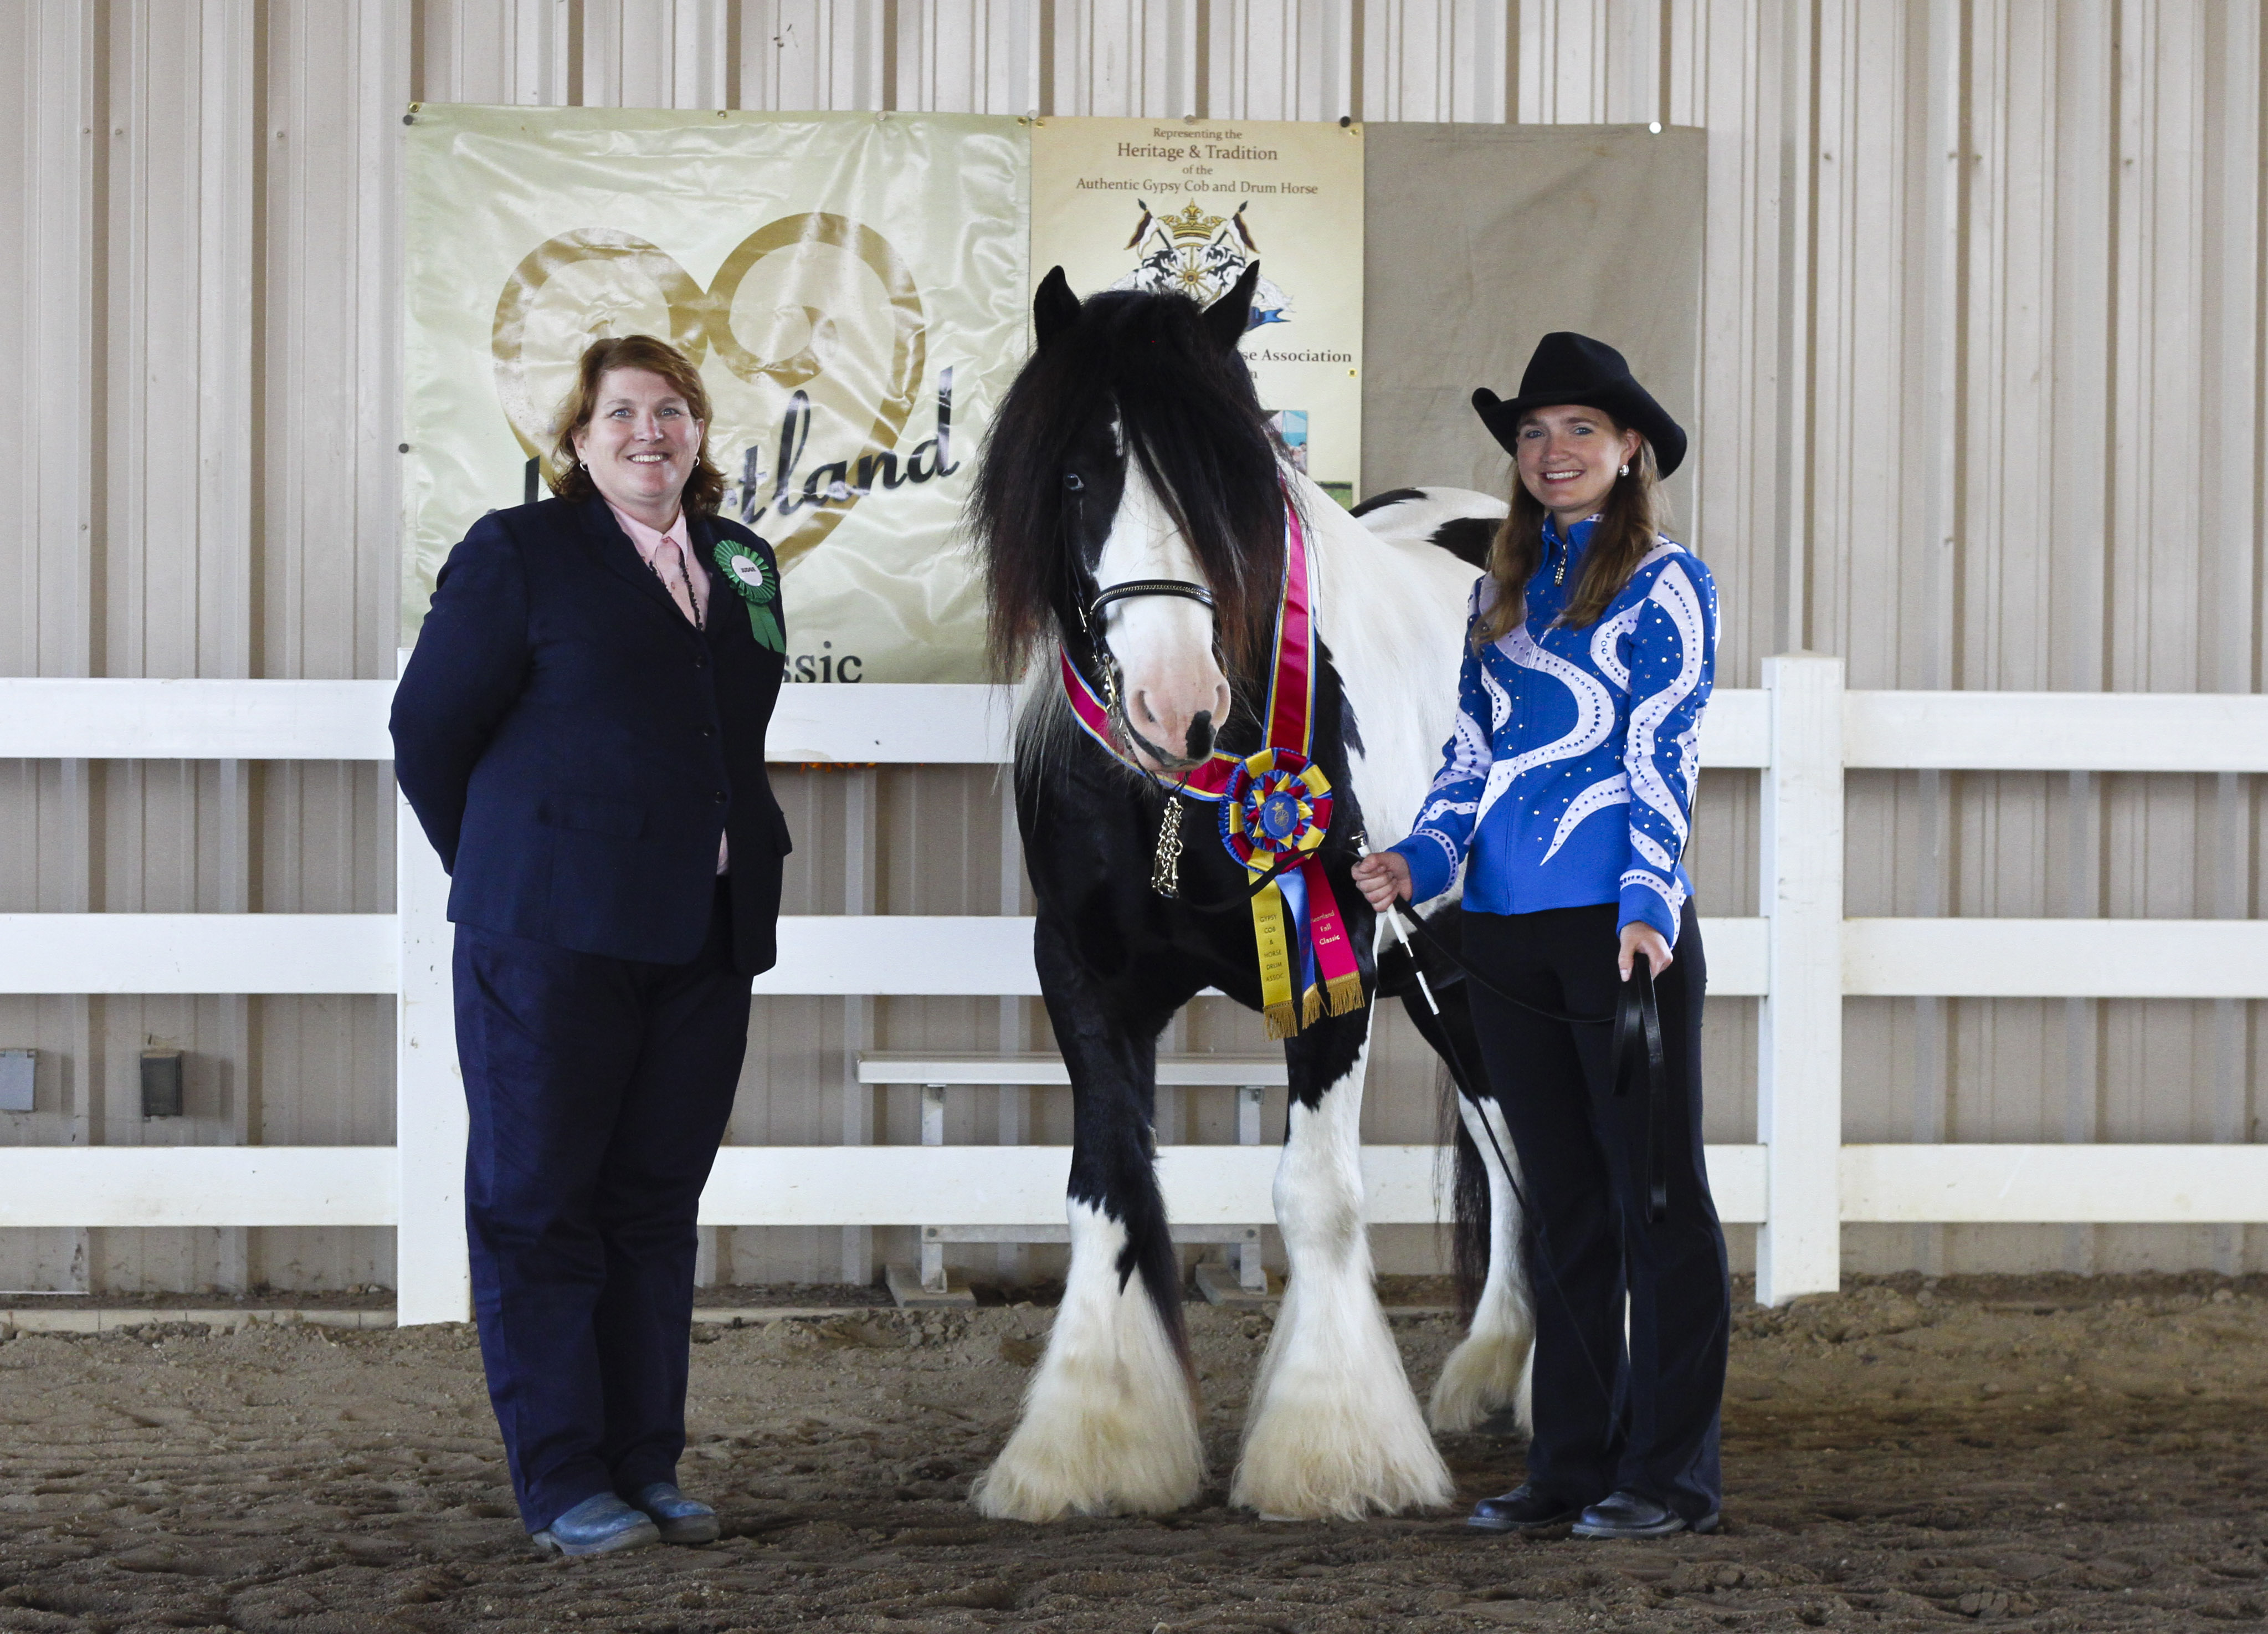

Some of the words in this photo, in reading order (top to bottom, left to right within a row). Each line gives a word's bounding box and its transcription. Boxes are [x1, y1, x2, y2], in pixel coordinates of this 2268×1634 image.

[1154, 127, 1222, 141] Representing
[1225, 129, 1242, 139] the
[1118, 142, 1184, 162] Heritage
[1189, 145, 1200, 158] &
[1206, 145, 1277, 160] Tradition
[1182, 164, 1194, 175] of
[1197, 165, 1213, 175] the
[1076, 178, 1140, 190] Authentic
[1143, 180, 1181, 194] Gypsy
[1184, 181, 1209, 192] Cob
[1212, 181, 1235, 192] and
[1240, 182, 1276, 193] Drum
[1281, 183, 1318, 194] Horse
[1262, 349, 1352, 362] Association
[1320, 923, 1332, 933] Fall
[1319, 934, 1341, 945] Classic
[1266, 974, 1283, 982] ASSOC
